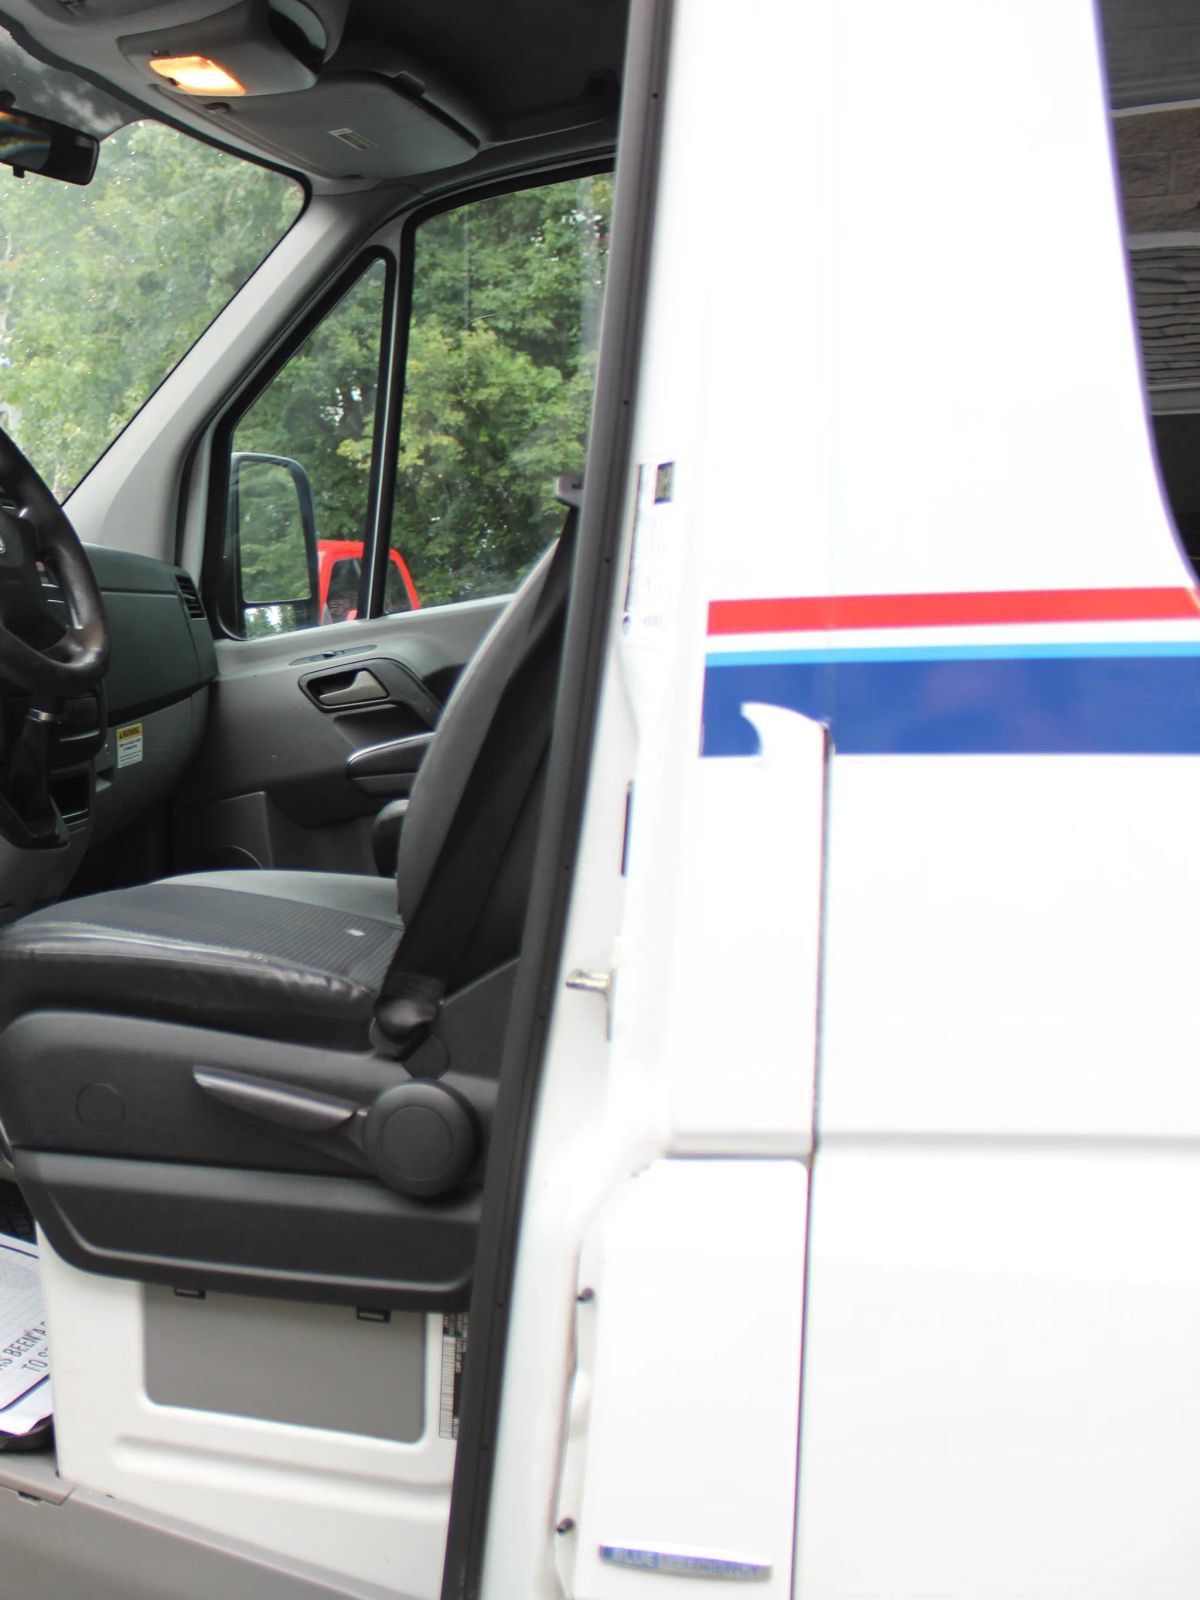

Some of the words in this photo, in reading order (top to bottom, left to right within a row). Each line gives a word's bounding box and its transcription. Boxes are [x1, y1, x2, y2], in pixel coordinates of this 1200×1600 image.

[2, 1334, 42, 1357] BEEN
[21, 1359, 48, 1372] TO
[613, 1548, 658, 1568] BLUE
